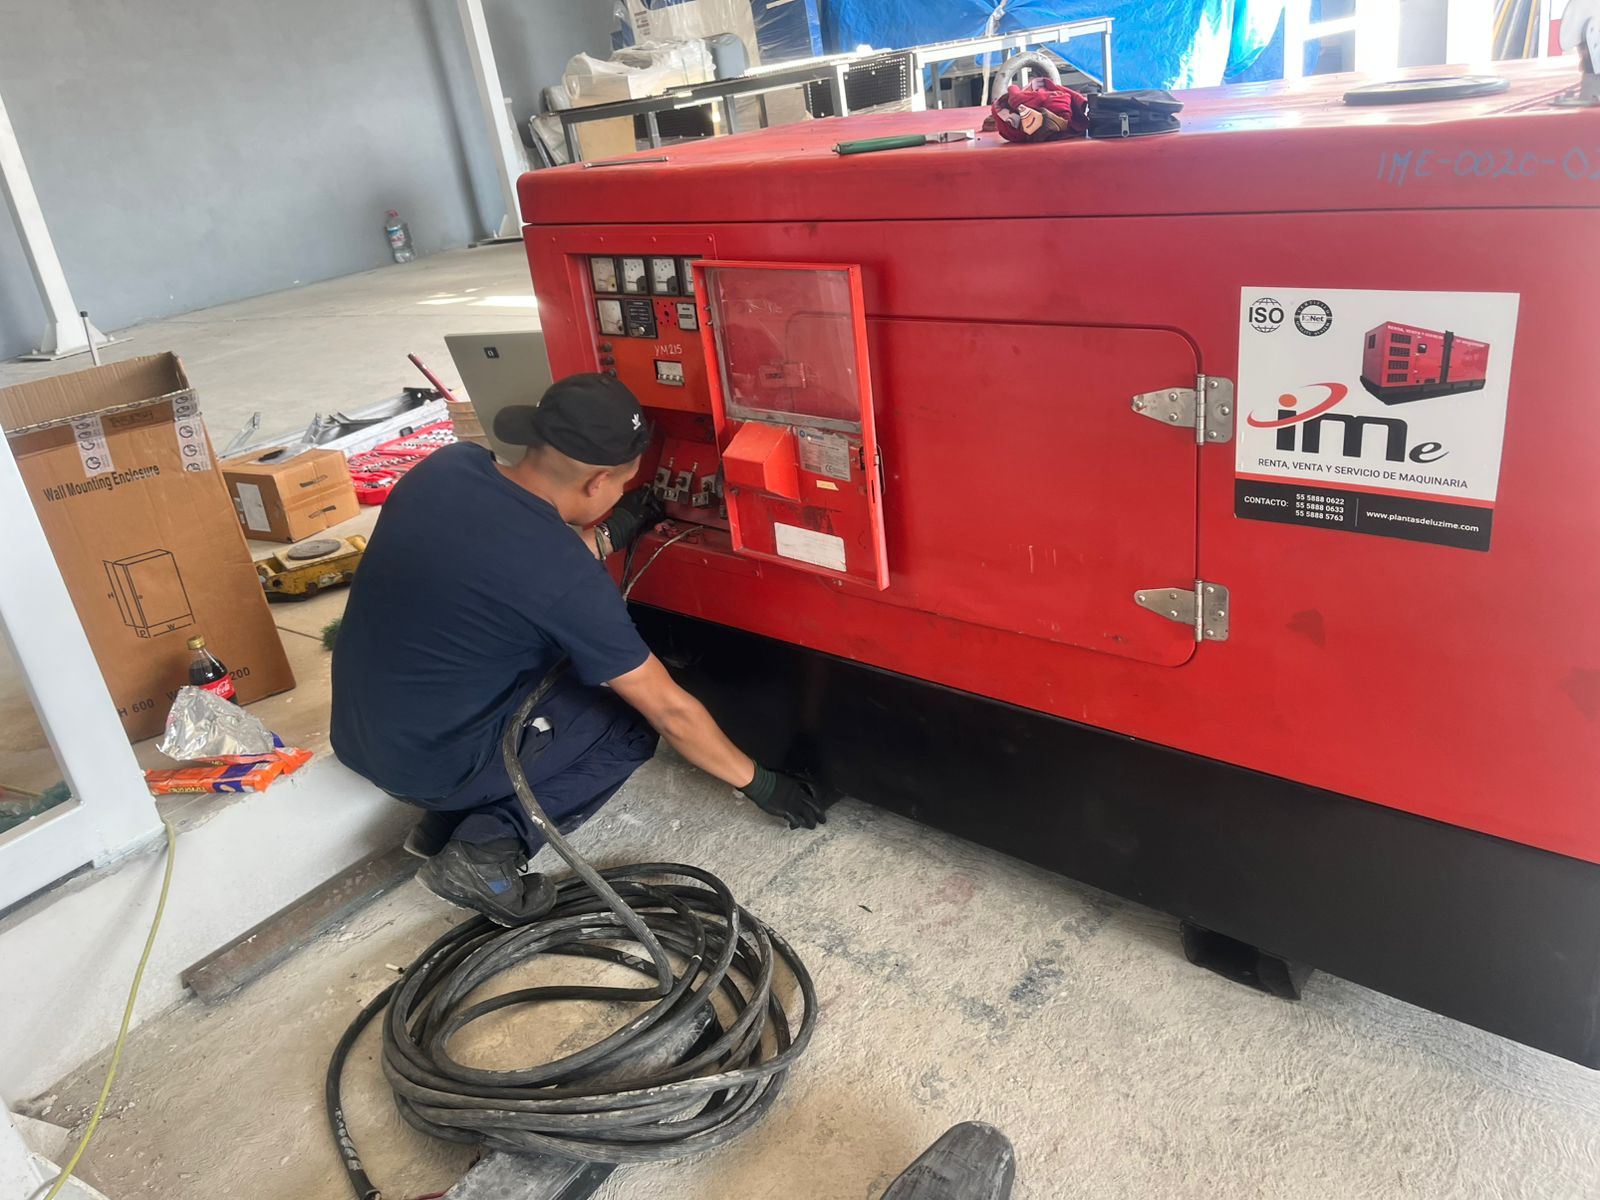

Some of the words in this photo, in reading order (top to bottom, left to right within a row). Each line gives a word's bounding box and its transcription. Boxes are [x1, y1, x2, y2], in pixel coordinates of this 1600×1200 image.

[1248, 306, 1285, 324] ISO
[43, 482, 67, 502] Wall
[65, 476, 113, 497] Mounting
[111, 464, 160, 486] Enclosure
[1258, 458, 1290, 470] RENTA,
[1292, 461, 1323, 473] VENTA
[1325, 464, 1332, 473] Y
[1334, 465, 1380, 479] SERVICIO
[1383, 470, 1396, 481] DE
[1399, 473, 1468, 489] MAQUINARIA
[1244, 495, 1289, 507] CONTACTO:
[1326, 497, 1345, 505] 0622
[1366, 511, 1479, 532] www.plantasdeluzime.com
[131, 698, 155, 713] 600
